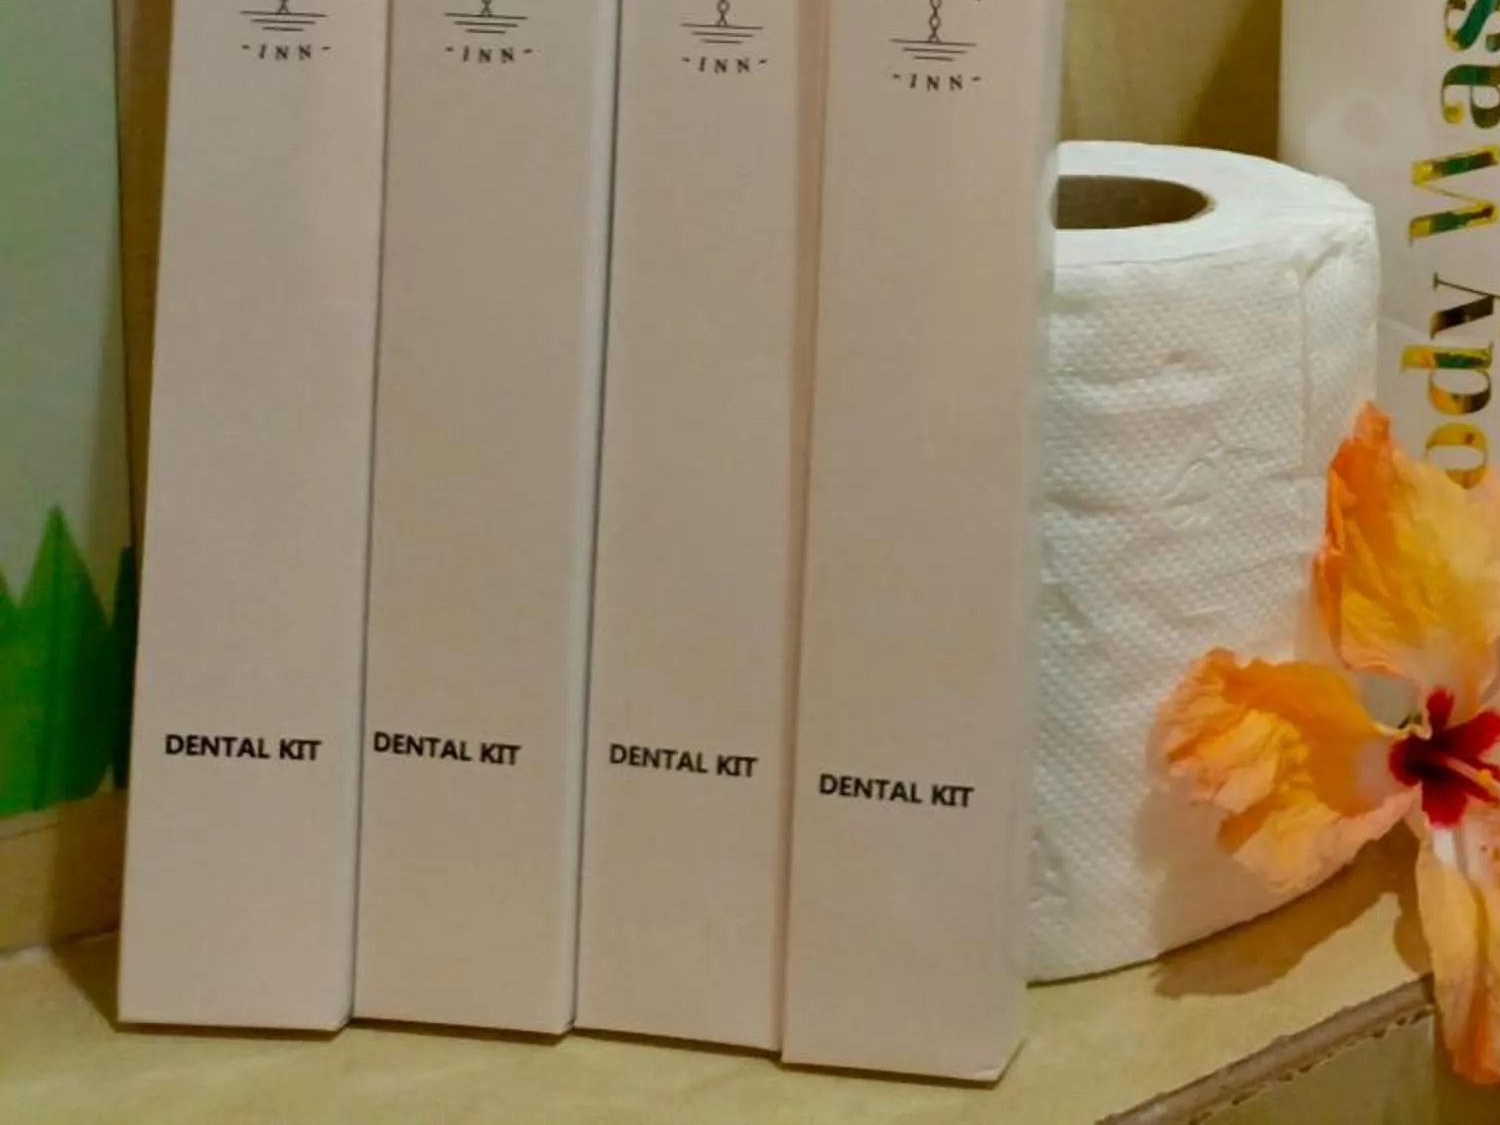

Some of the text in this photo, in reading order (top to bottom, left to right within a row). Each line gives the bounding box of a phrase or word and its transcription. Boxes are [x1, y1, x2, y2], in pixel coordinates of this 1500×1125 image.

[165, 733, 322, 762] DENTAL KIT
[372, 731, 523, 767] DENTAL KIT
[608, 742, 759, 778] DENTAL KIT
[818, 772, 975, 809] DENTAL KIT
